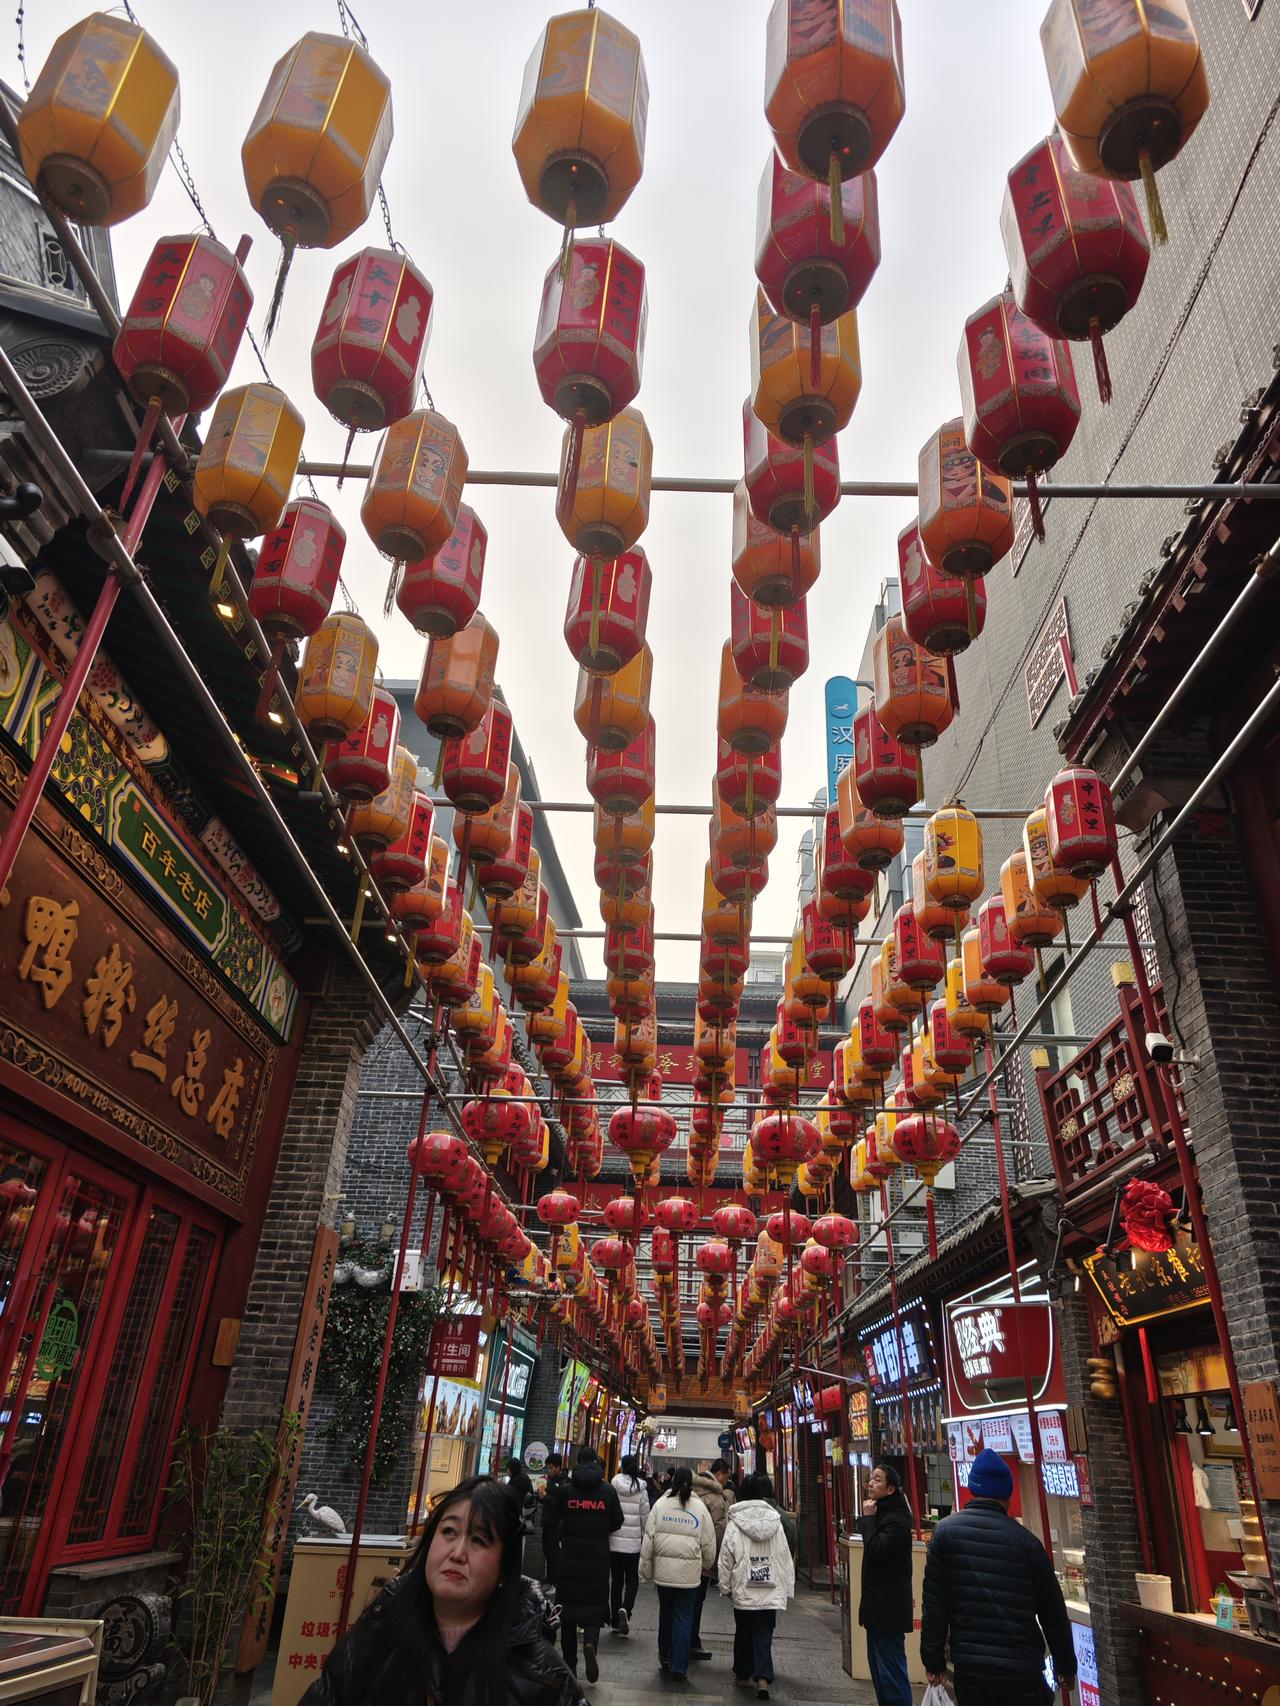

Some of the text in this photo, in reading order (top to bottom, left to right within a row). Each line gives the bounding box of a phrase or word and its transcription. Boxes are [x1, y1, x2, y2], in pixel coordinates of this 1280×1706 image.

[832, 726, 855, 803] 汉庭
[141, 821, 213, 921] 百年老店
[433, 1342, 471, 1358] 卫生间
[568, 1500, 606, 1511] CHINA
